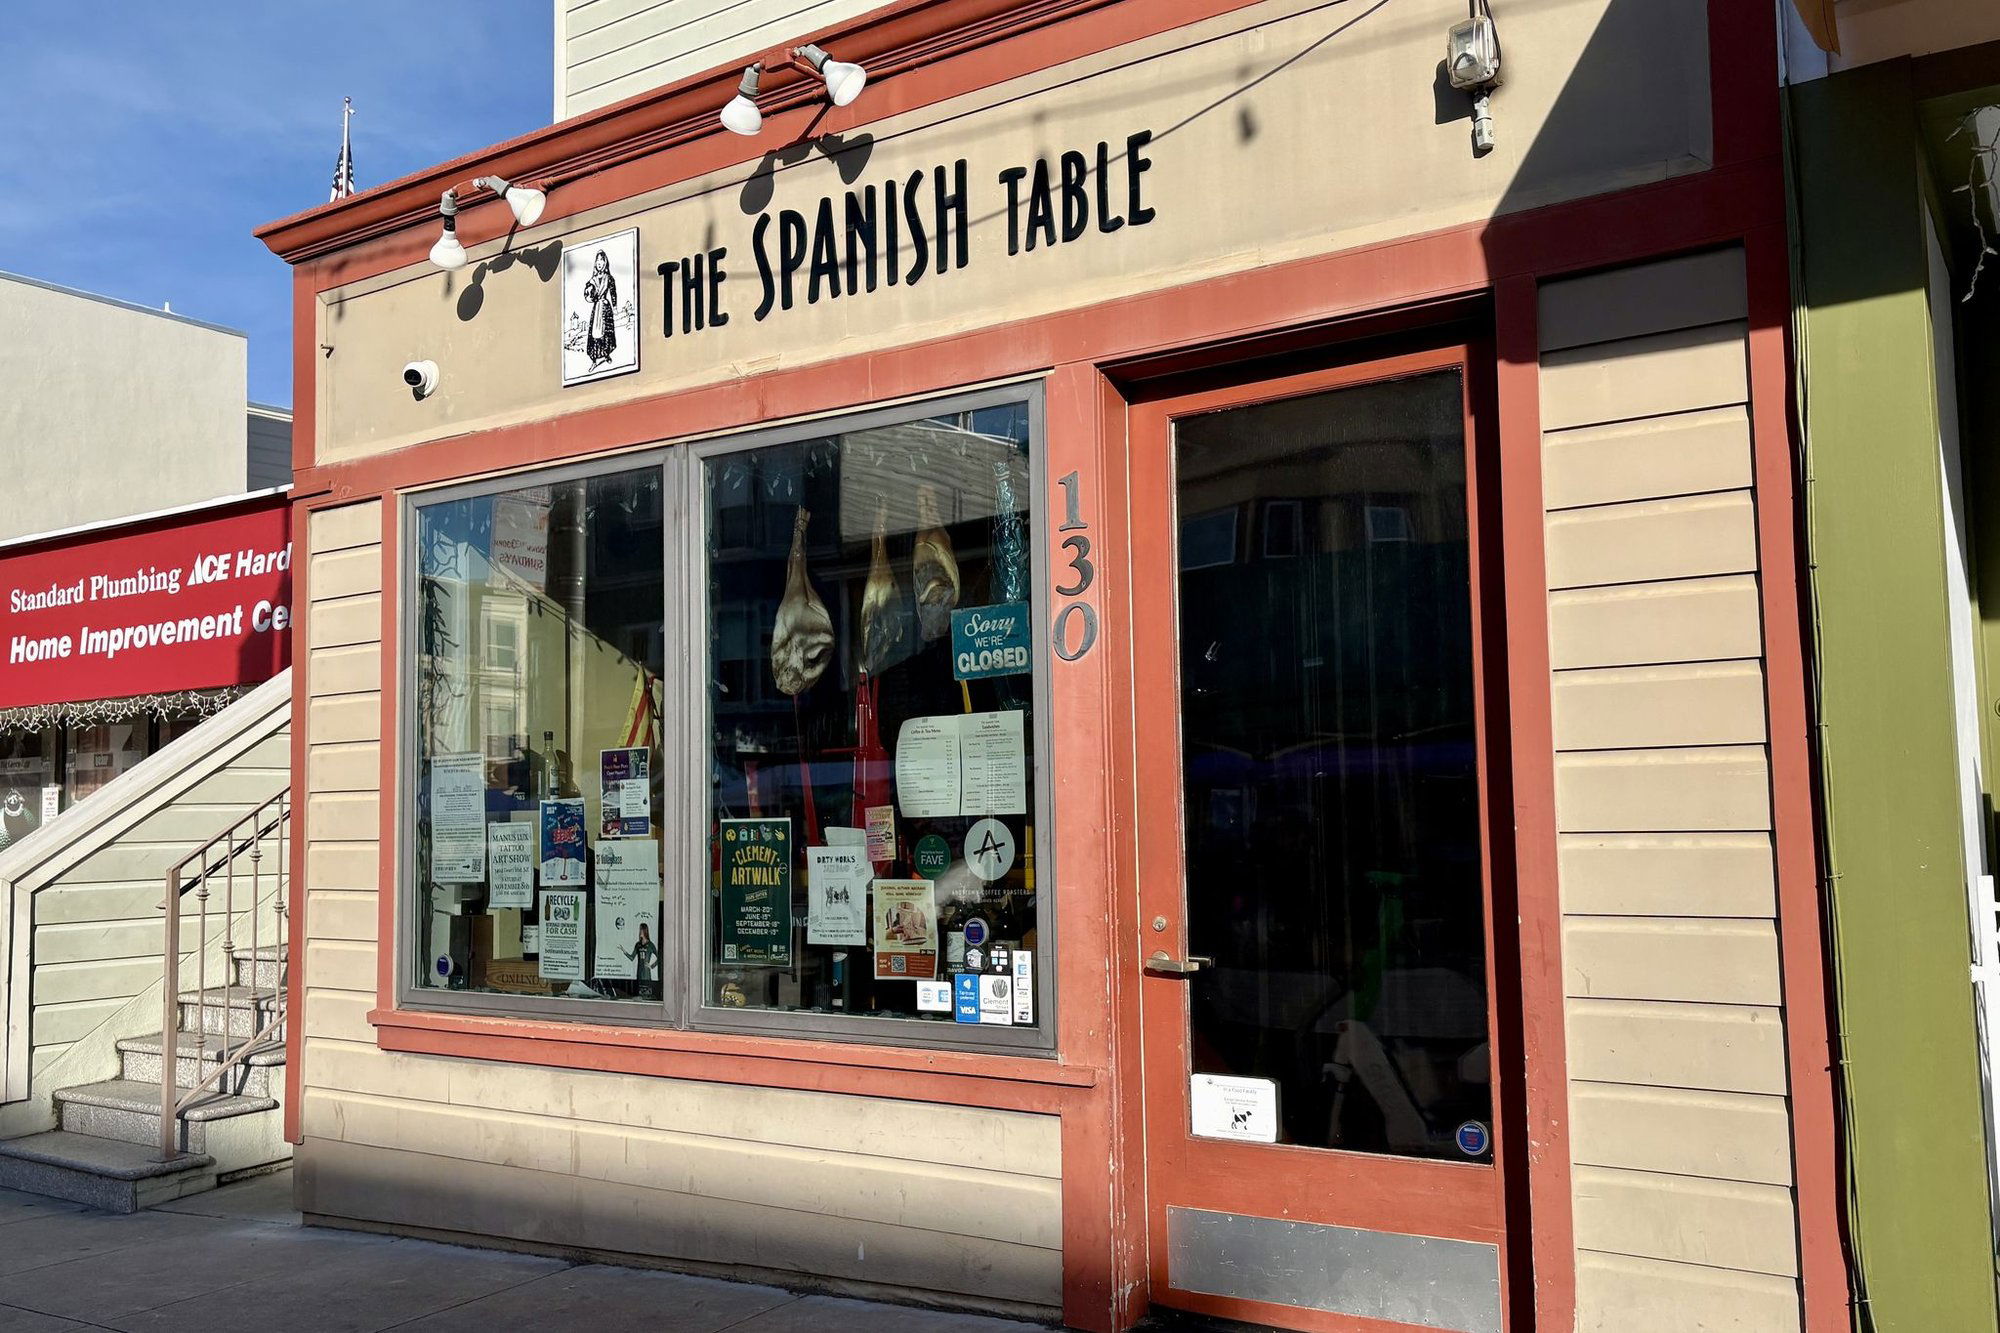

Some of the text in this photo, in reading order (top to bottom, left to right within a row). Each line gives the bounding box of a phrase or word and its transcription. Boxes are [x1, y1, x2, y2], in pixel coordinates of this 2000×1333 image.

[657, 129, 1156, 338] THE SPANISH TABLE
[1053, 470, 1098, 661] 130
[10, 579, 84, 614] Standard
[90, 566, 182, 602] Plumbing
[186, 552, 231, 587] ACE
[10, 634, 72, 664] Home
[80, 604, 244, 659] Improvement
[964, 613, 1016, 639] Sorry
[974, 636, 1004, 648] WE'RE
[957, 646, 1029, 673] CLOSED
[500, 844, 525, 852] TATTOO
[735, 845, 778, 866] CLEMENT
[492, 854, 531, 864] ART SHOW
[921, 855, 944, 865] FAVE
[731, 867, 781, 886] ARTWALK
[550, 895, 574, 906] RECYCLE
[560, 928, 577, 936] CASH
[960, 1006, 976, 1014] VISA
